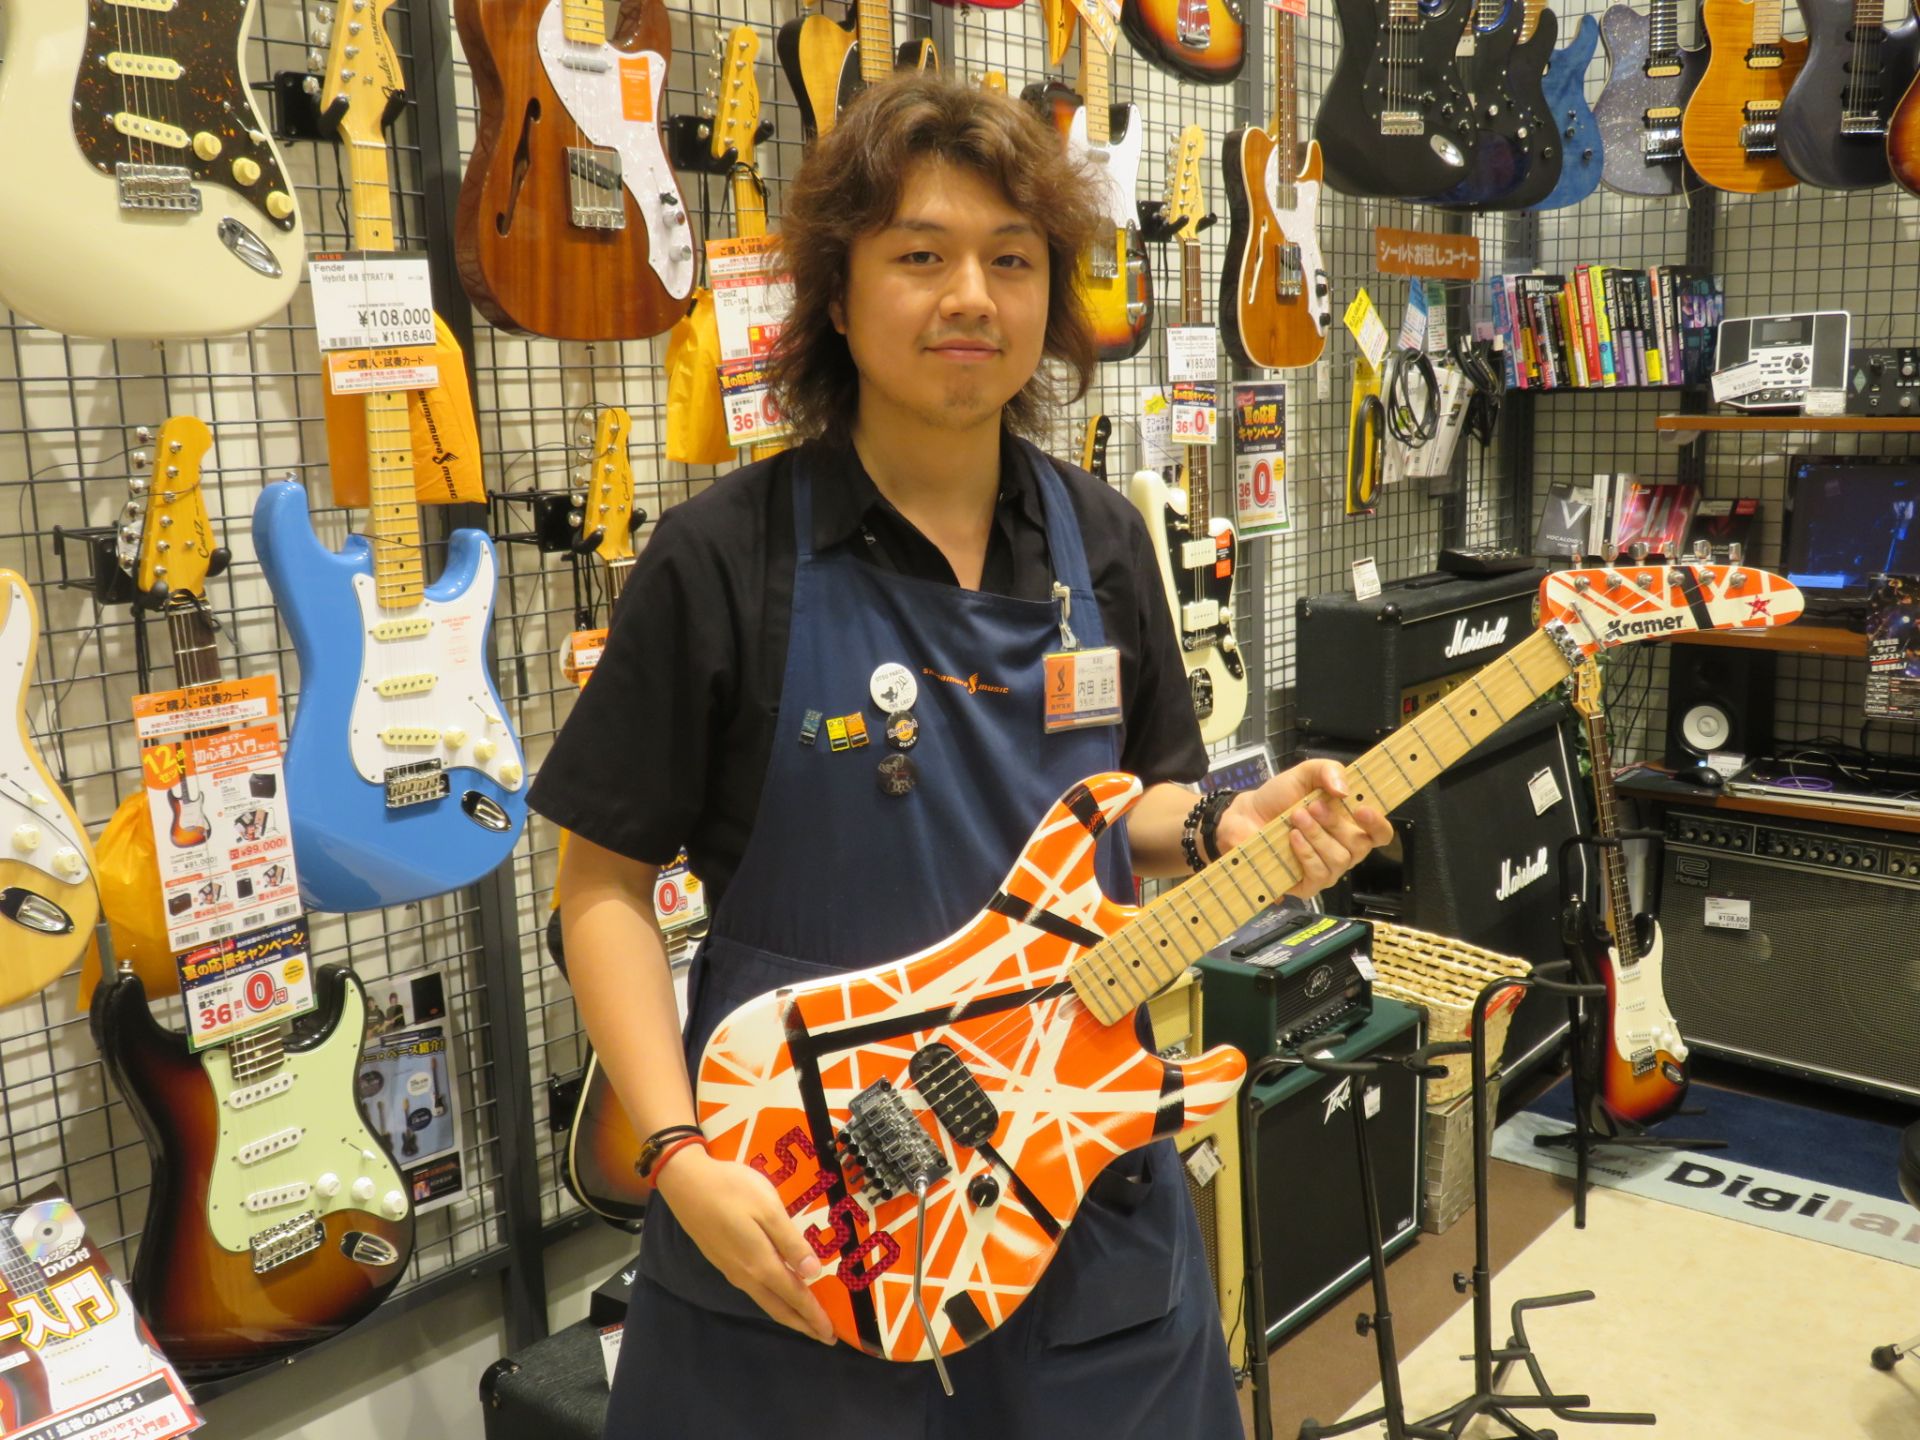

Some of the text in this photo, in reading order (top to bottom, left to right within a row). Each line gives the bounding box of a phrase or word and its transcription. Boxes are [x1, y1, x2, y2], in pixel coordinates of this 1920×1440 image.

[1380, 240, 1476, 269] シールドお試しコーナー
[313, 263, 345, 273] Fender
[322, 274, 347, 284] Hybrid
[357, 308, 432, 327] ¥108,000
[382, 329, 433, 344] ¥116,640
[348, 355, 425, 371] ご購入・試奏カード
[733, 413, 754, 432] 36
[1243, 403, 1278, 426] 夏の応援
[1175, 420, 1189, 434] 36
[1238, 425, 1283, 441] キャンペーン
[1238, 482, 1251, 497] 36
[1445, 616, 1509, 658] Marshall
[1606, 615, 1684, 642] Kramer
[155, 688, 250, 713] ご購入・試奏カード
[143, 744, 177, 775] 12
[1496, 846, 1549, 901] Marshall
[1675, 874, 1709, 888] Roland
[182, 932, 305, 981] 夏の応援キャンペーン
[198, 999, 215, 1010] 最大
[200, 1003, 232, 1031] 36
[43, 1246, 91, 1279] DVD付
